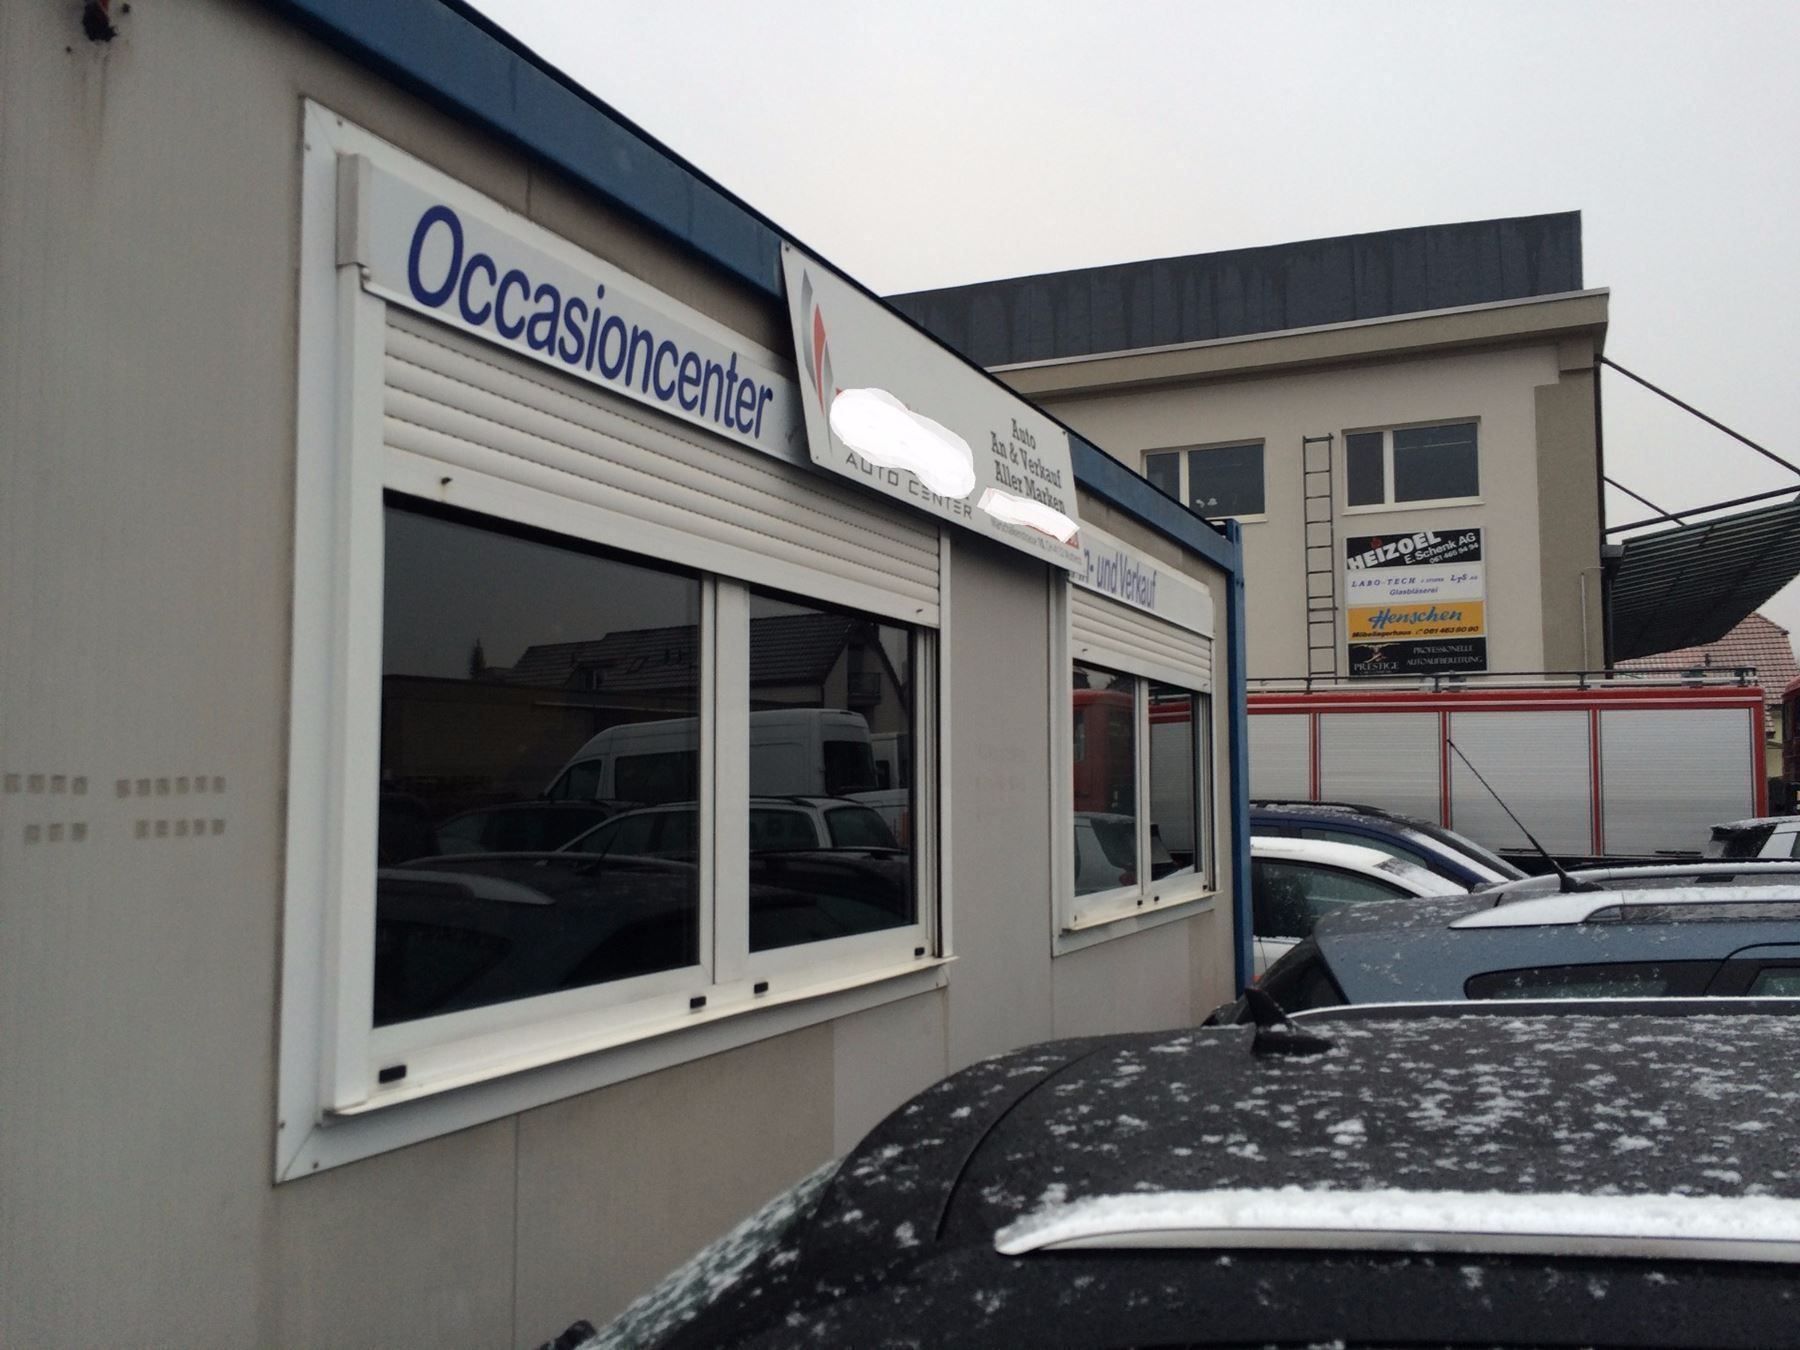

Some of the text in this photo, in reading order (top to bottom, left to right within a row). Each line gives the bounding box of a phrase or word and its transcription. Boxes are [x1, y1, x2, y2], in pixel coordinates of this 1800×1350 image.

[408, 204, 773, 439] Occasioncenter
[1011, 417, 1036, 451] Auto
[990, 430, 1062, 489] An & Verkauf
[845, 452, 973, 520] AUTO CENTER
[994, 460, 1067, 515] Aller Marken
[1347, 531, 1442, 570] HEIZOEL
[1403, 532, 1476, 565] E. Schenk AG
[1096, 552, 1119, 595] und
[1119, 553, 1157, 610] Verkauf
[1389, 587, 1438, 596] Glasbläserei
[1368, 606, 1463, 629] Henschen
[1353, 661, 1400, 671] PRESTIGE
[1413, 645, 1473, 655] PROFESSIONELLE
